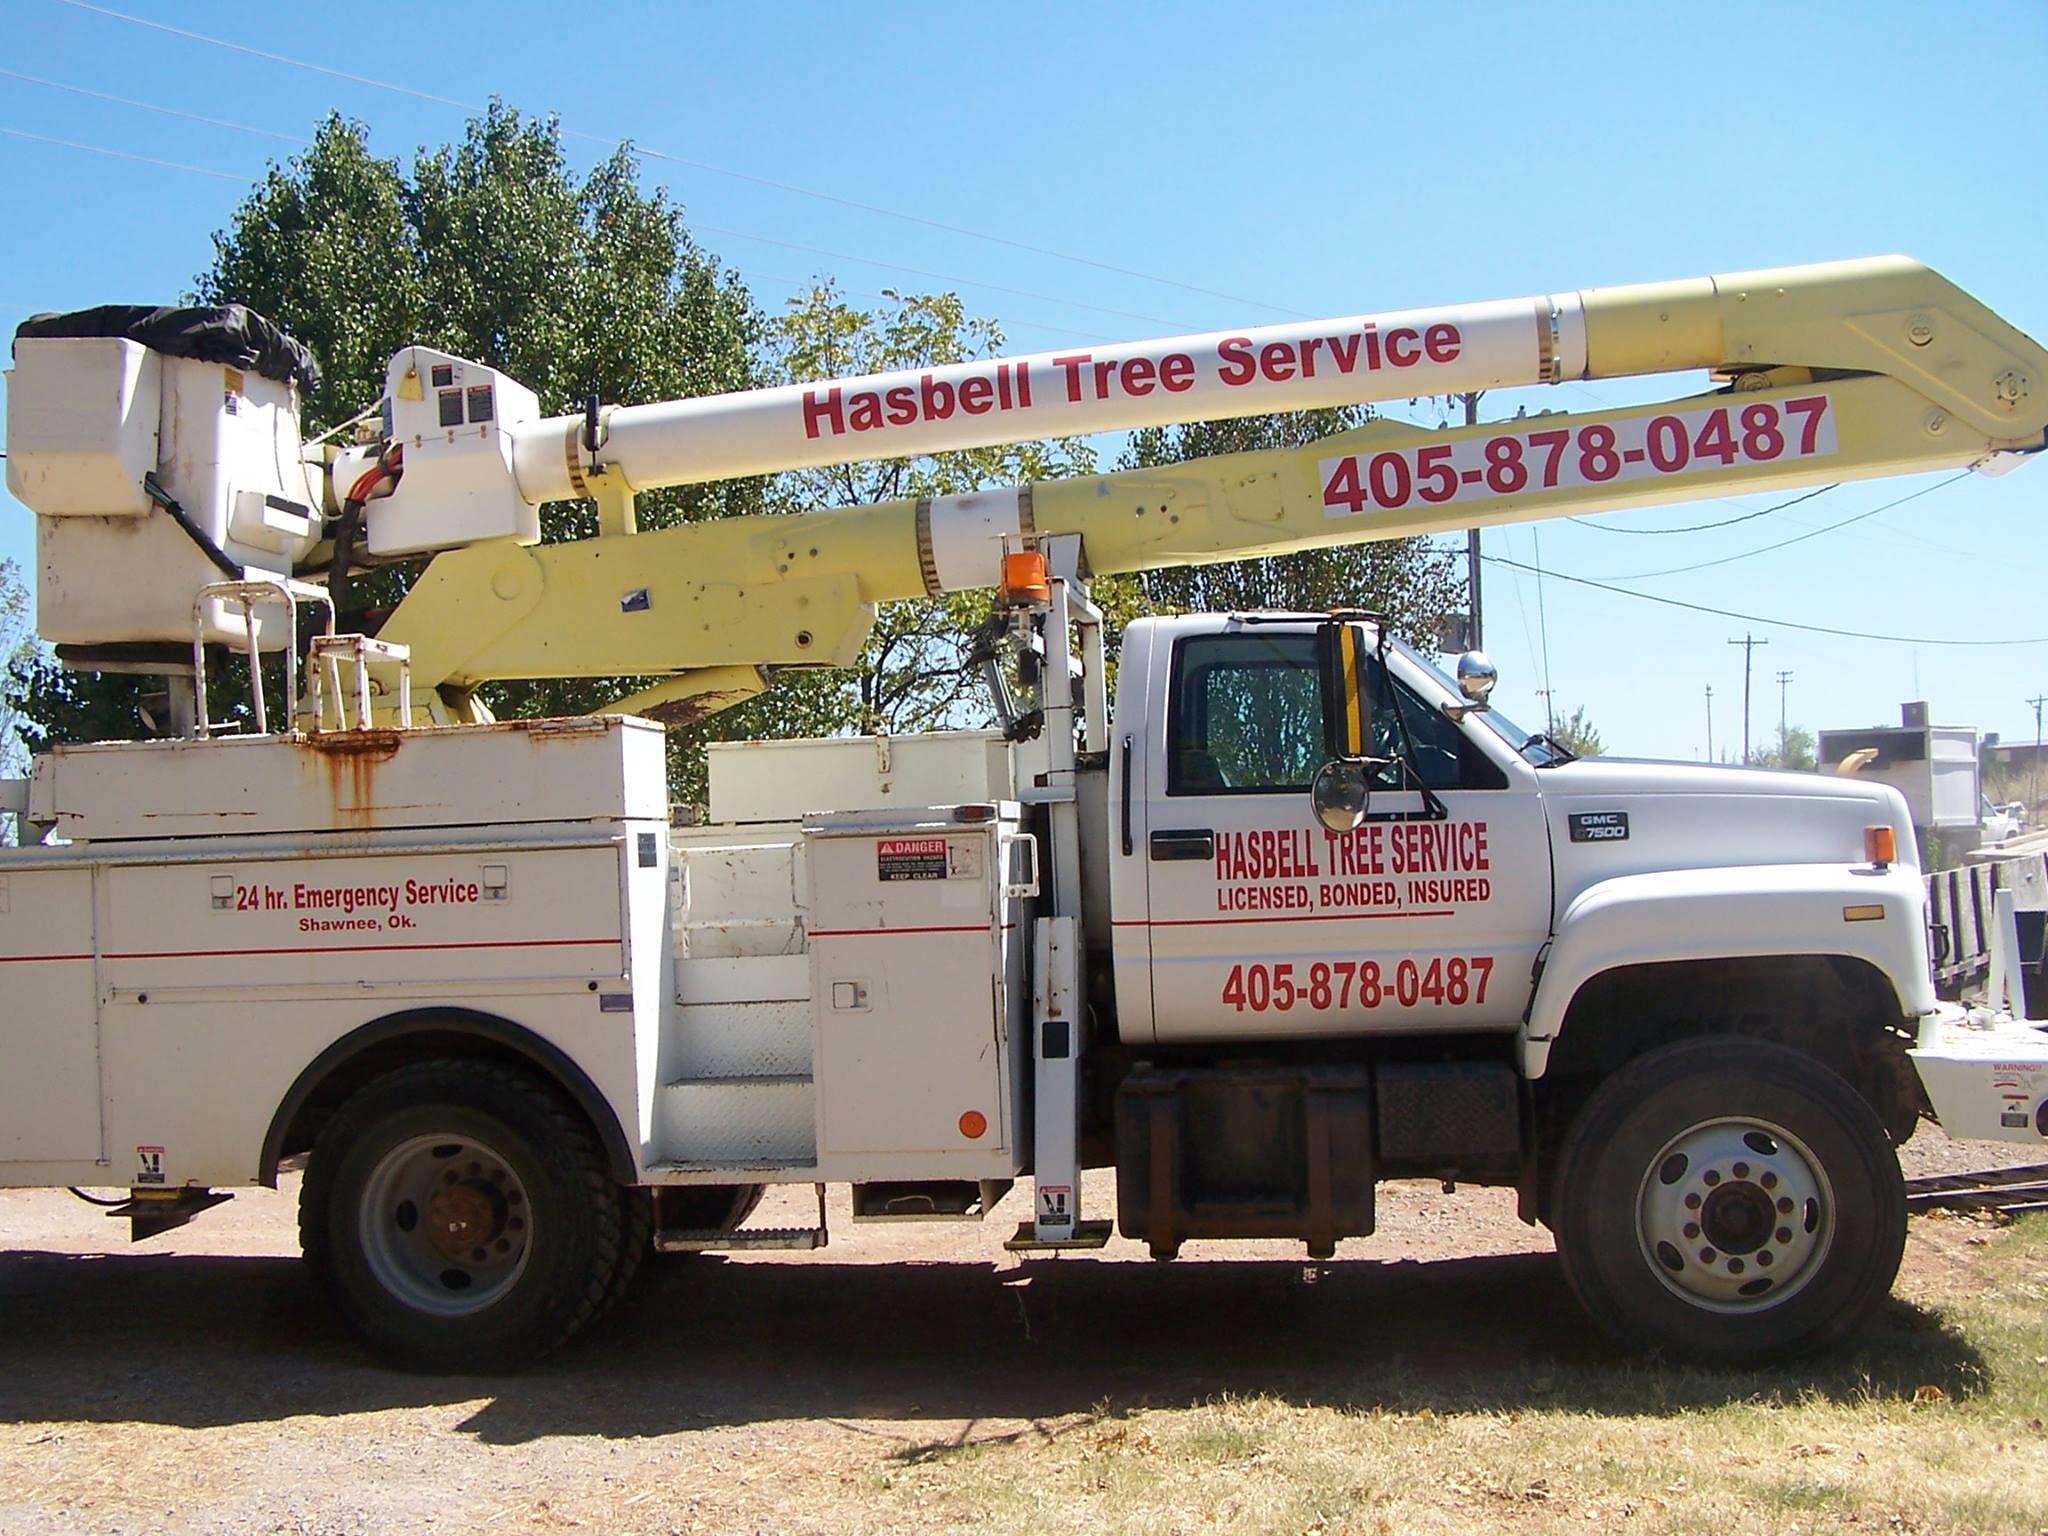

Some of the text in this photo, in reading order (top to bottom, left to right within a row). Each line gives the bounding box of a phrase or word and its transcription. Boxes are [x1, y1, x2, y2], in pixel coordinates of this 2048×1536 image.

[802, 322, 1461, 440] Hasbell Tree Service
[1322, 396, 1828, 513] 405-878-0487
[1580, 815, 1618, 825] GMC
[895, 841, 944, 854] DANGER
[1215, 822, 1490, 881] HASBELL TREE SERVICE
[237, 877, 479, 914] 24 hr. Emergency Service
[1216, 877, 1491, 913] LICENSED, BONDED, INSURED
[299, 914, 417, 932] Shawnee, Ok.
[1221, 955, 1495, 1013] 405-878-0487
